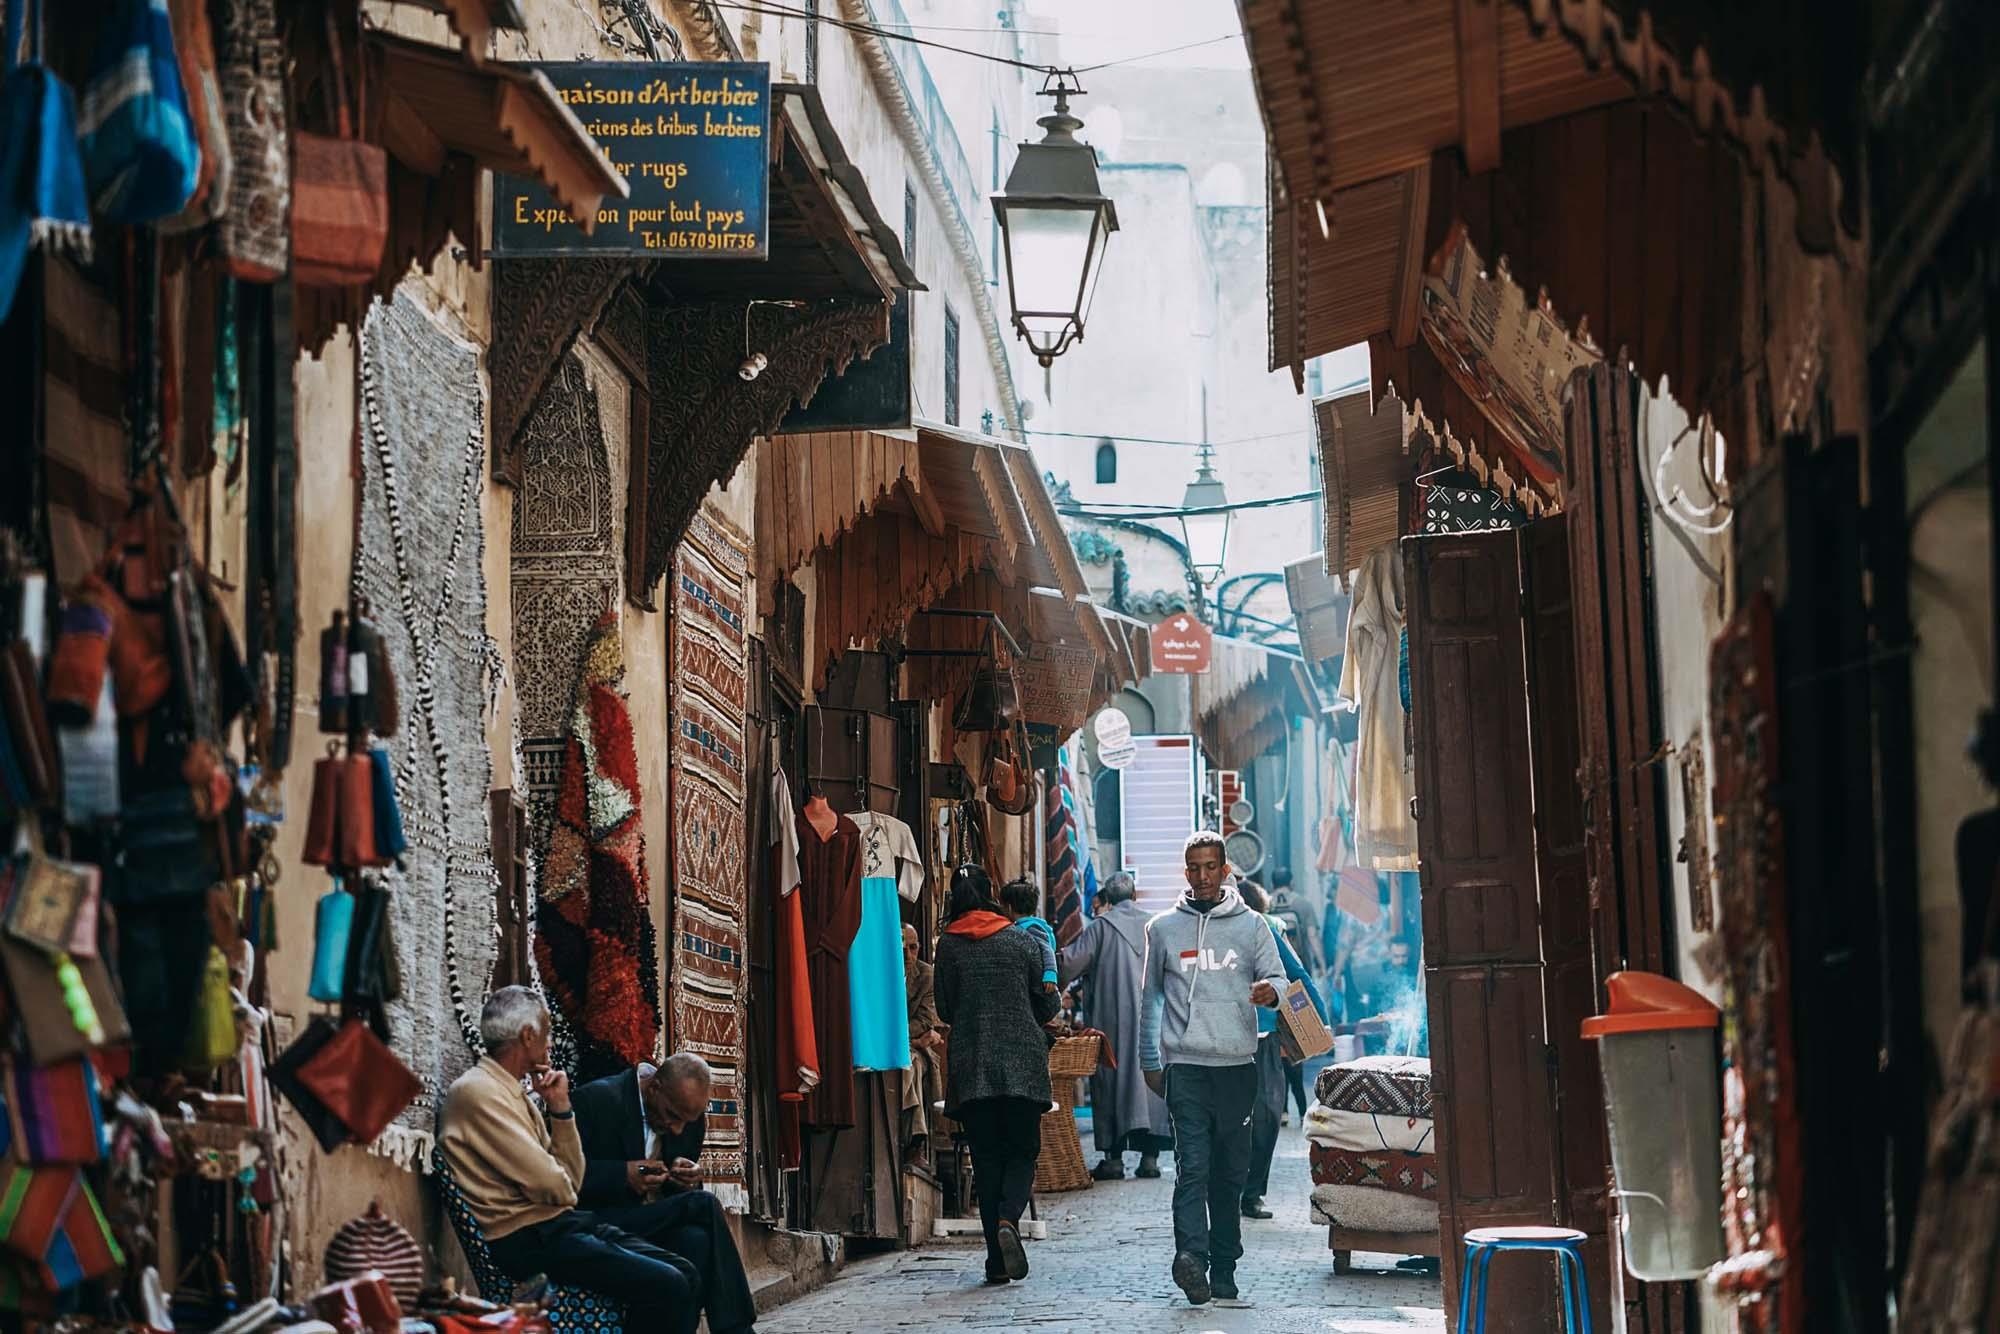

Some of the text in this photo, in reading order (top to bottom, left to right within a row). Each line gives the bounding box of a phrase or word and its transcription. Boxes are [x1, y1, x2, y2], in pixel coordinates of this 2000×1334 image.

[638, 80, 688, 104] d'Art
[690, 77, 759, 106] berbère
[583, 111, 761, 137] ciens des tribus berbères
[642, 162, 688, 189] rugs
[629, 209, 666, 232] pour
[670, 200, 702, 222] tout
[707, 209, 745, 231] pays
[1180, 949, 1239, 971] FILA
